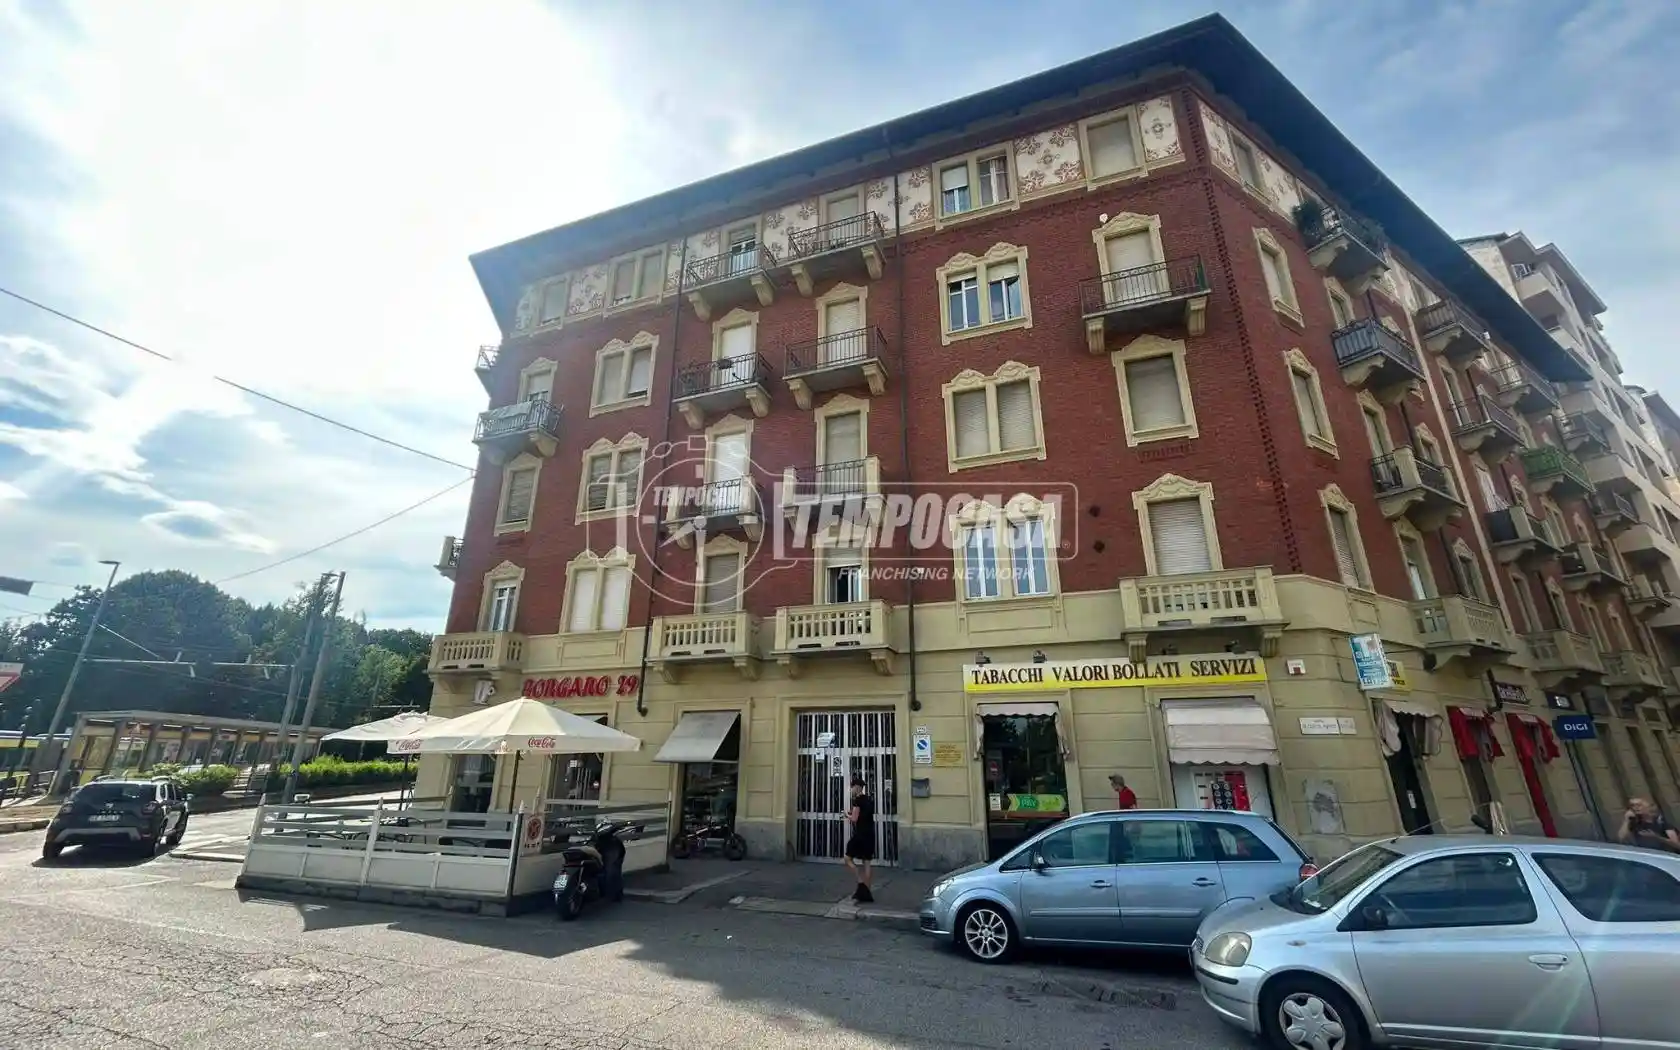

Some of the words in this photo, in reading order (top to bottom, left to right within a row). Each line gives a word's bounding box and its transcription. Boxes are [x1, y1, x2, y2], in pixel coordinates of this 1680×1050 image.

[971, 667, 1043, 685] TABACCHI
[1052, 664, 1110, 682] VALORI
[1113, 661, 1181, 680] BOLLATI
[1190, 659, 1257, 677] SERVIZI
[523, 675, 610, 698] BORGARO
[616, 674, 640, 696] 29
[1563, 722, 1589, 732] DIGI
